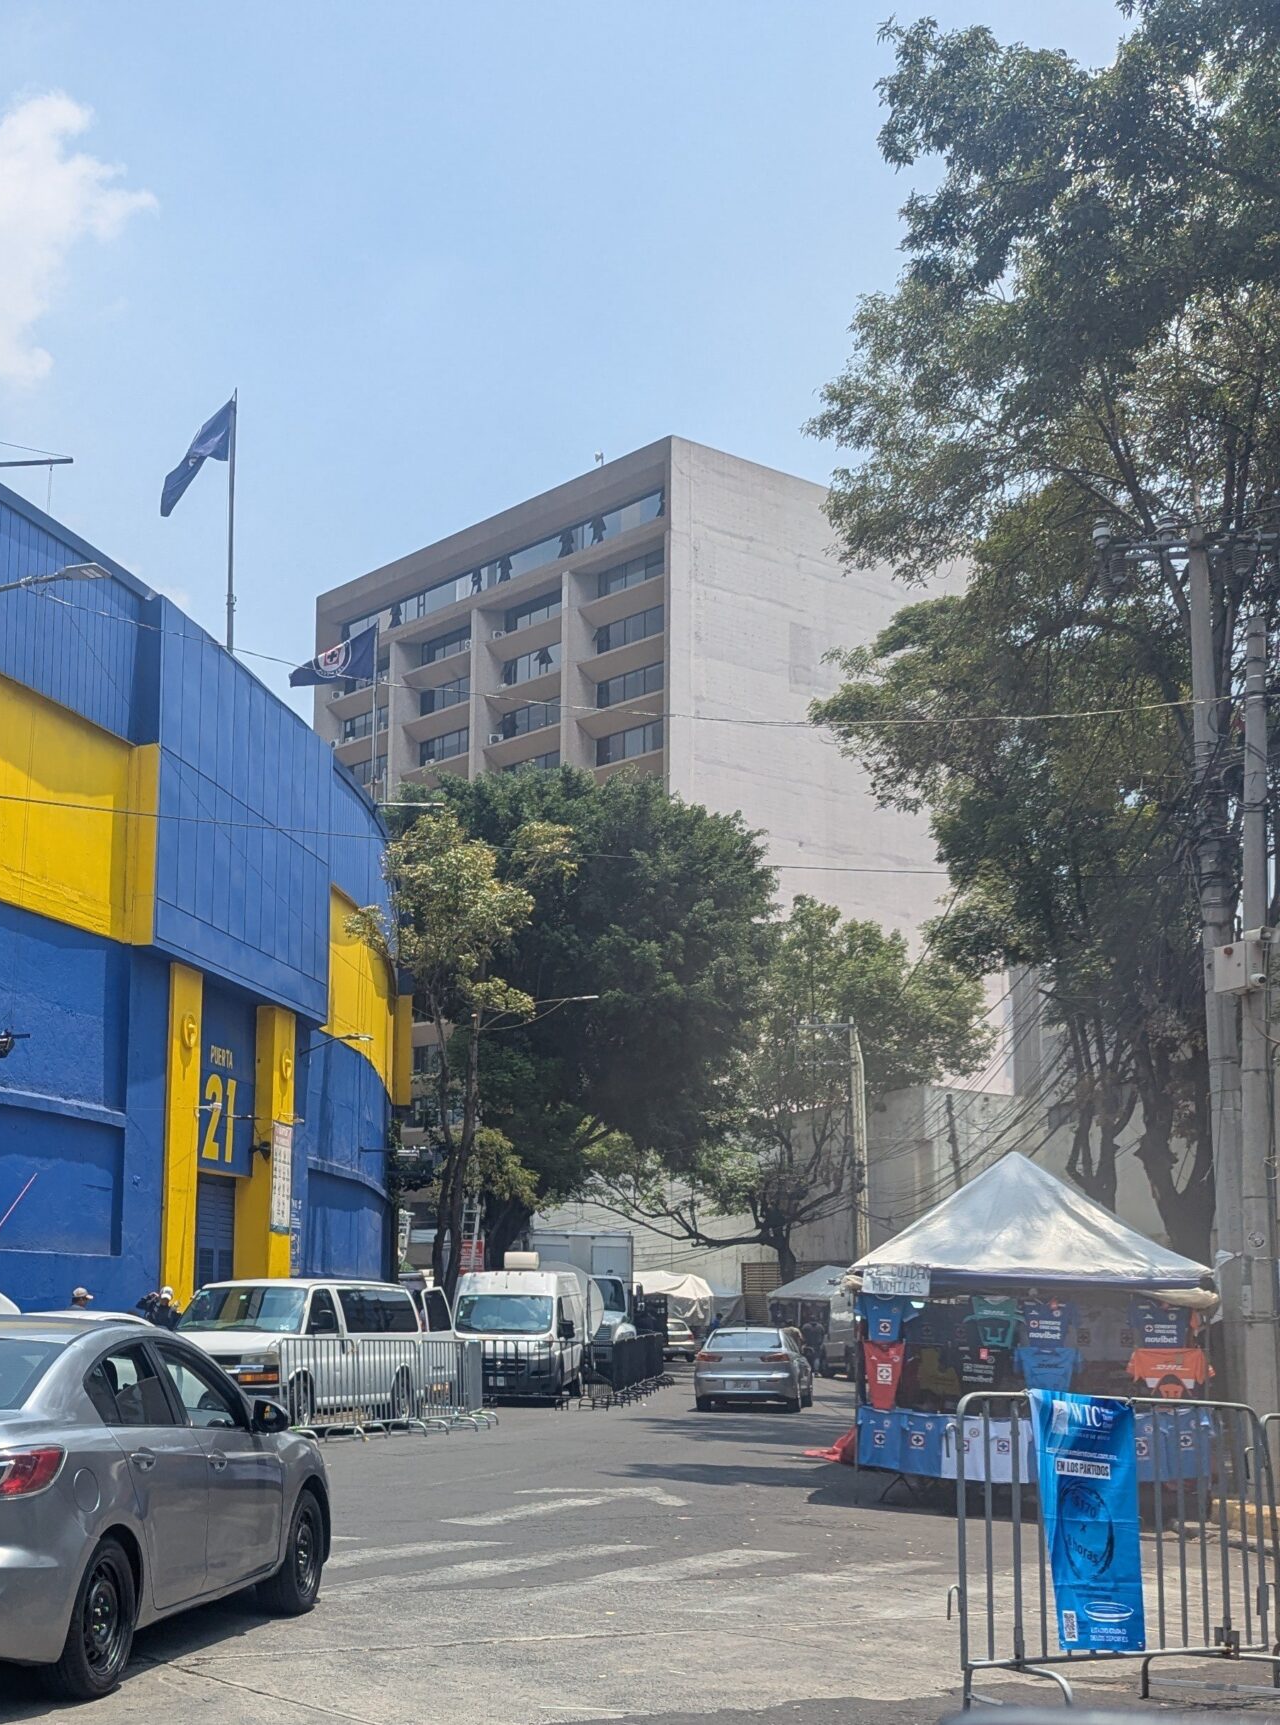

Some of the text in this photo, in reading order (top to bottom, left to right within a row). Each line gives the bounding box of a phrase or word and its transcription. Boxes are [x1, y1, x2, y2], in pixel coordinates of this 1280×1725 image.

[210, 1045, 234, 1070] PUERTA
[202, 1073, 237, 1164] 21
[1029, 1331, 1061, 1340] novibet
[1145, 1335, 1178, 1344] novibet
[1070, 1402, 1102, 1427] WTC
[1056, 1460, 1109, 1477] EN LOS PARTIDOS
[1072, 1537, 1100, 1565] horas
